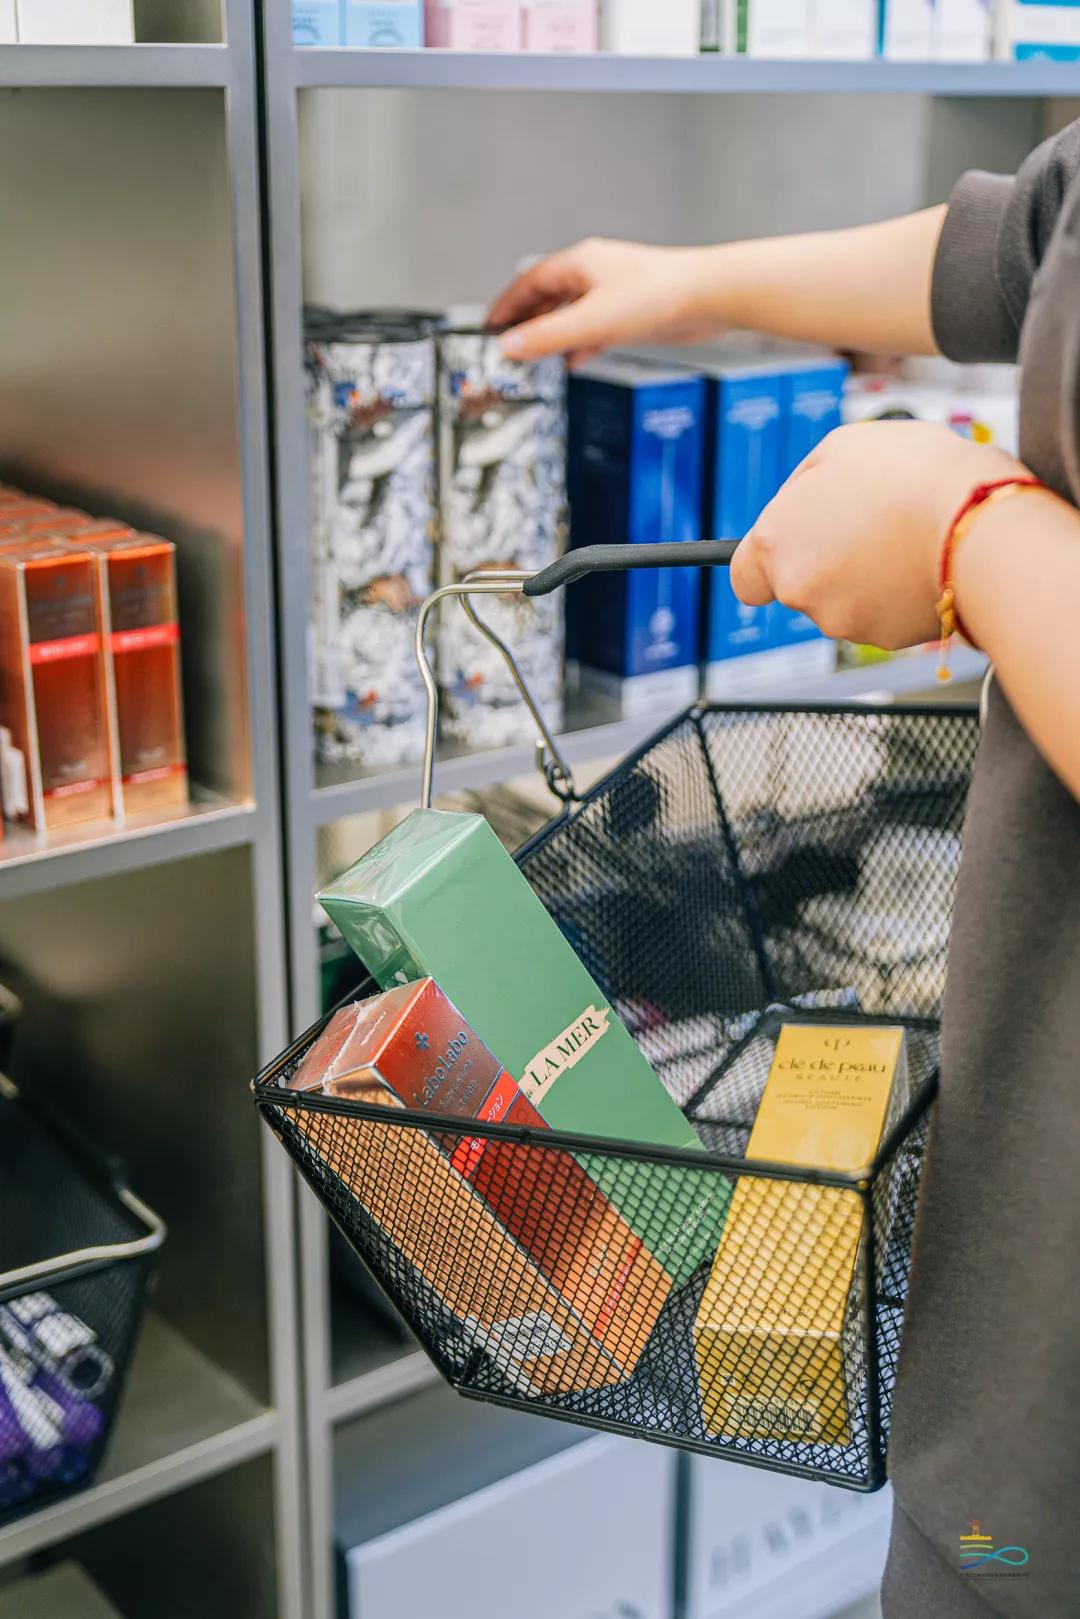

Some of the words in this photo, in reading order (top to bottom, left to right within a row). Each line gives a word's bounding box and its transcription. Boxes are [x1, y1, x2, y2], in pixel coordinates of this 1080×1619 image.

[530, 1057, 560, 1087] LA
[556, 1016, 601, 1062] MER
[838, 1061, 887, 1074] peau
